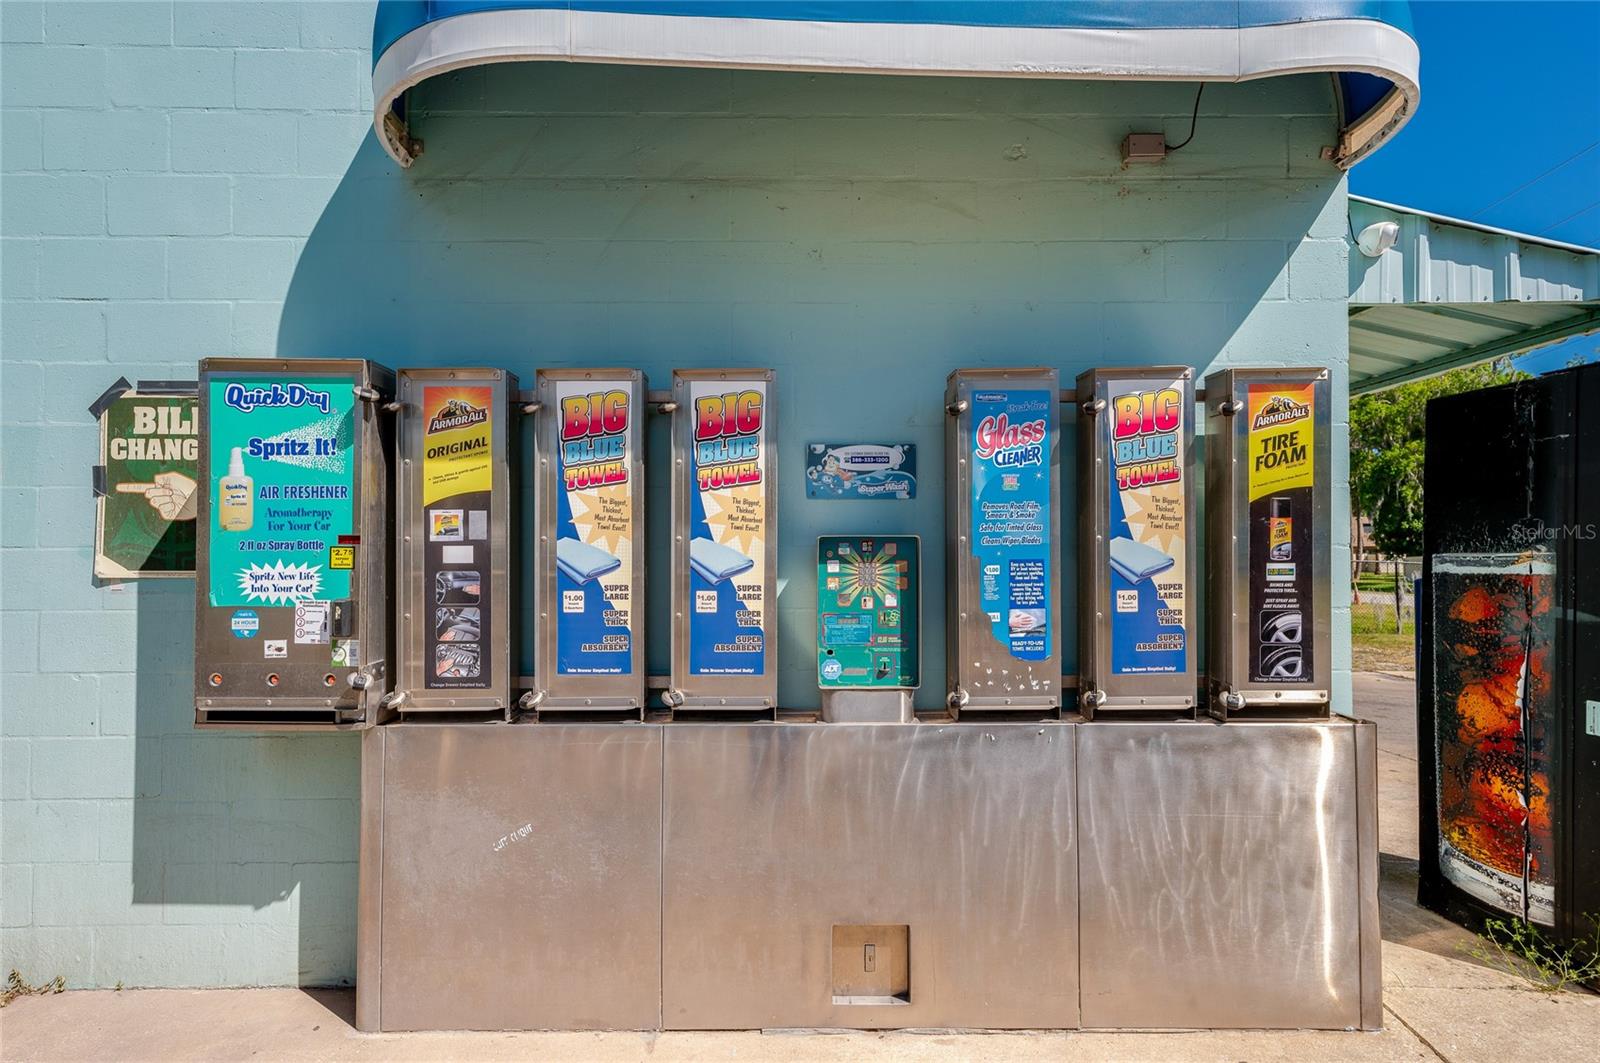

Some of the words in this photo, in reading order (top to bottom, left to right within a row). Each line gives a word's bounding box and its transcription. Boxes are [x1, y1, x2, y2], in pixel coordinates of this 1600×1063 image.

[562, 389, 628, 439] BIG
[696, 389, 762, 439] BIG
[1114, 389, 1180, 438] BIG
[976, 413, 1046, 458] Glass
[1261, 431, 1299, 454] TIRE
[248, 437, 309, 460] Spritz
[315, 437, 337, 456] It!
[427, 436, 488, 459] ORIGINAL
[564, 435, 625, 465] BLUE
[697, 435, 758, 465] BLUE
[994, 446, 1042, 466] CLEANER
[1116, 434, 1176, 464] BLUE
[1255, 445, 1306, 472] FOAM
[565, 462, 627, 490] TOWEL
[698, 462, 761, 490] TOWEL
[1117, 461, 1180, 489] TOWEL
[260, 486, 279, 499] AIR
[284, 486, 348, 499] FRESHENER
[1152, 495, 1160, 503] The
[266, 507, 332, 520] Aromatherapy
[1016, 511, 1035, 519] Smoke
[268, 521, 285, 531] For
[288, 521, 311, 531] Your
[314, 521, 331, 531] Car
[980, 523, 993, 531] Safe
[995, 523, 1005, 531] for
[1026, 523, 1042, 531] Glass
[240, 541, 245, 550] 2
[248, 541, 254, 550] fl
[257, 542, 266, 550] oz
[268, 541, 295, 551] Spray
[297, 540, 324, 550] Bottle
[1002, 537, 1020, 546] Wiper
[249, 572, 275, 583] Spritz
[278, 572, 296, 580] New
[299, 571, 315, 580] Life
[251, 584, 269, 592] Into
[272, 584, 293, 592] Your
[296, 583, 313, 592] Car!
